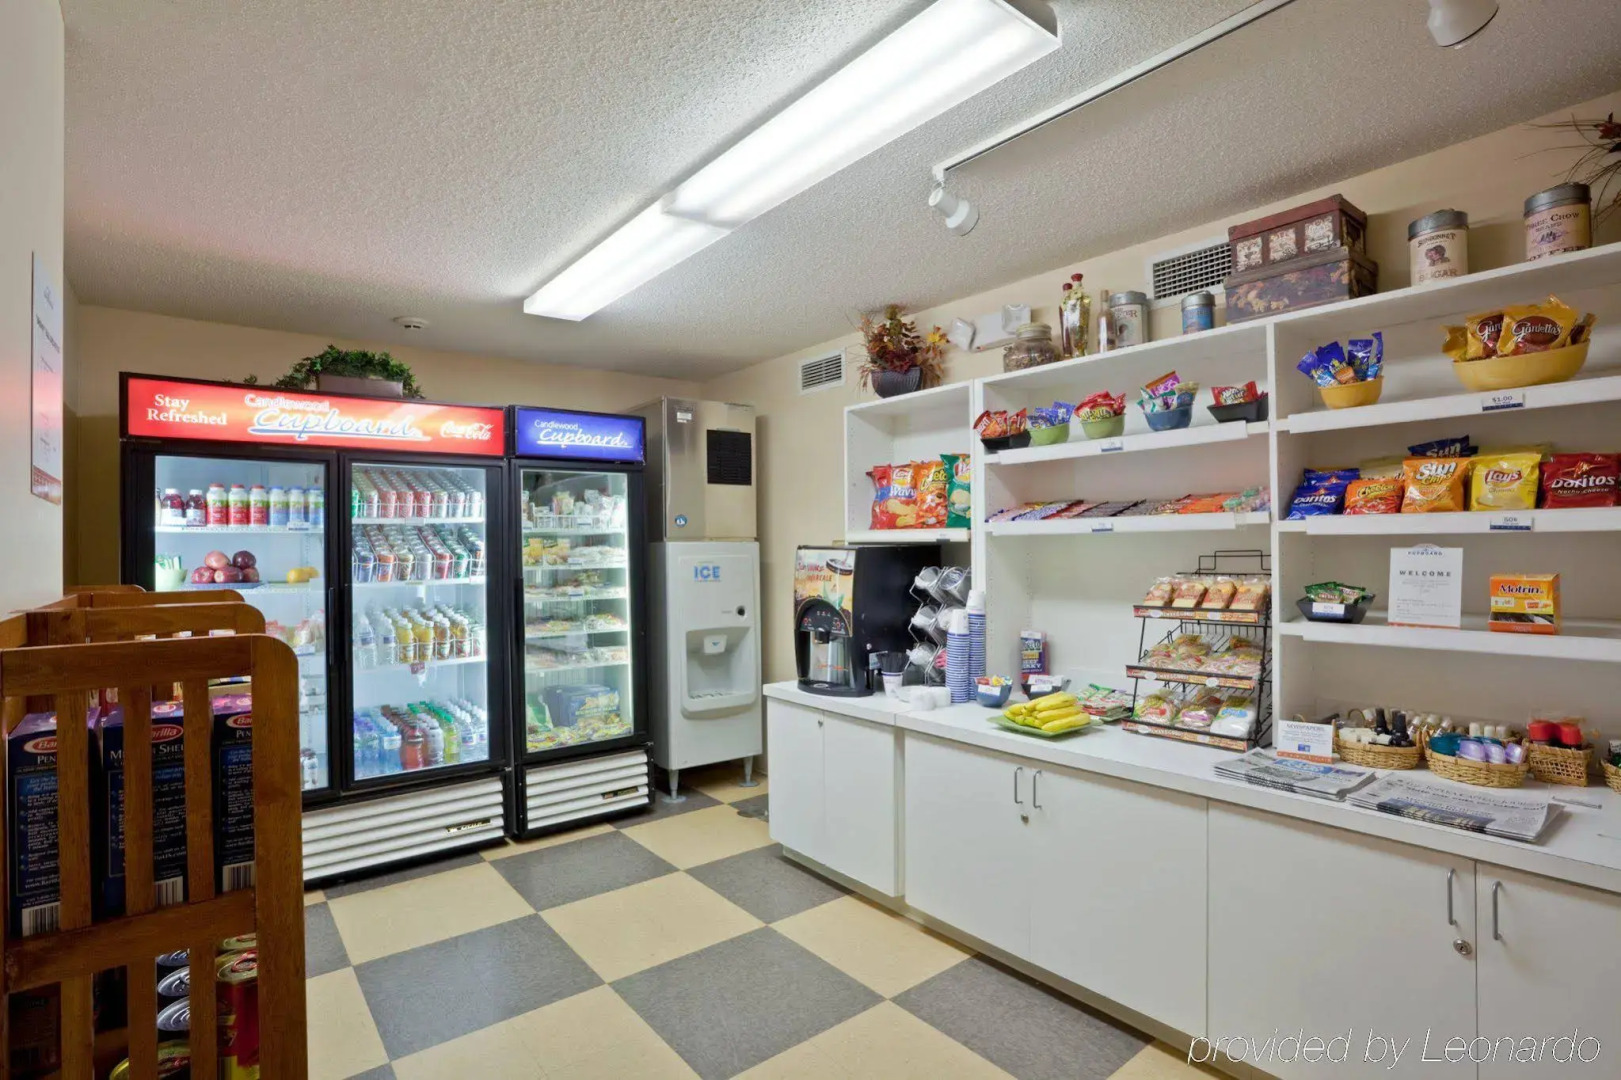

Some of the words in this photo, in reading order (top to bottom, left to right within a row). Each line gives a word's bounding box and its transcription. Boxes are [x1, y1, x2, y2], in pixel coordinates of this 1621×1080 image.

[1550, 212, 1580, 222] CROW
[1511, 321, 1562, 342] Gardetto's
[154, 394, 190, 411] Stay
[244, 393, 331, 413] Candlewood
[147, 408, 228, 426] Refreshed
[251, 408, 424, 441] Cupboard
[534, 419, 579, 431] Candlewood
[439, 420, 494, 441] Coca-Cola
[538, 428, 623, 448] Cupboard
[1426, 442, 1461, 457] Sun
[1416, 461, 1457, 479] Sun
[1551, 475, 1616, 488] Doritos
[1294, 494, 1337, 504] Doritos
[693, 565, 721, 579] ICE
[1499, 584, 1540, 594] Motrin
